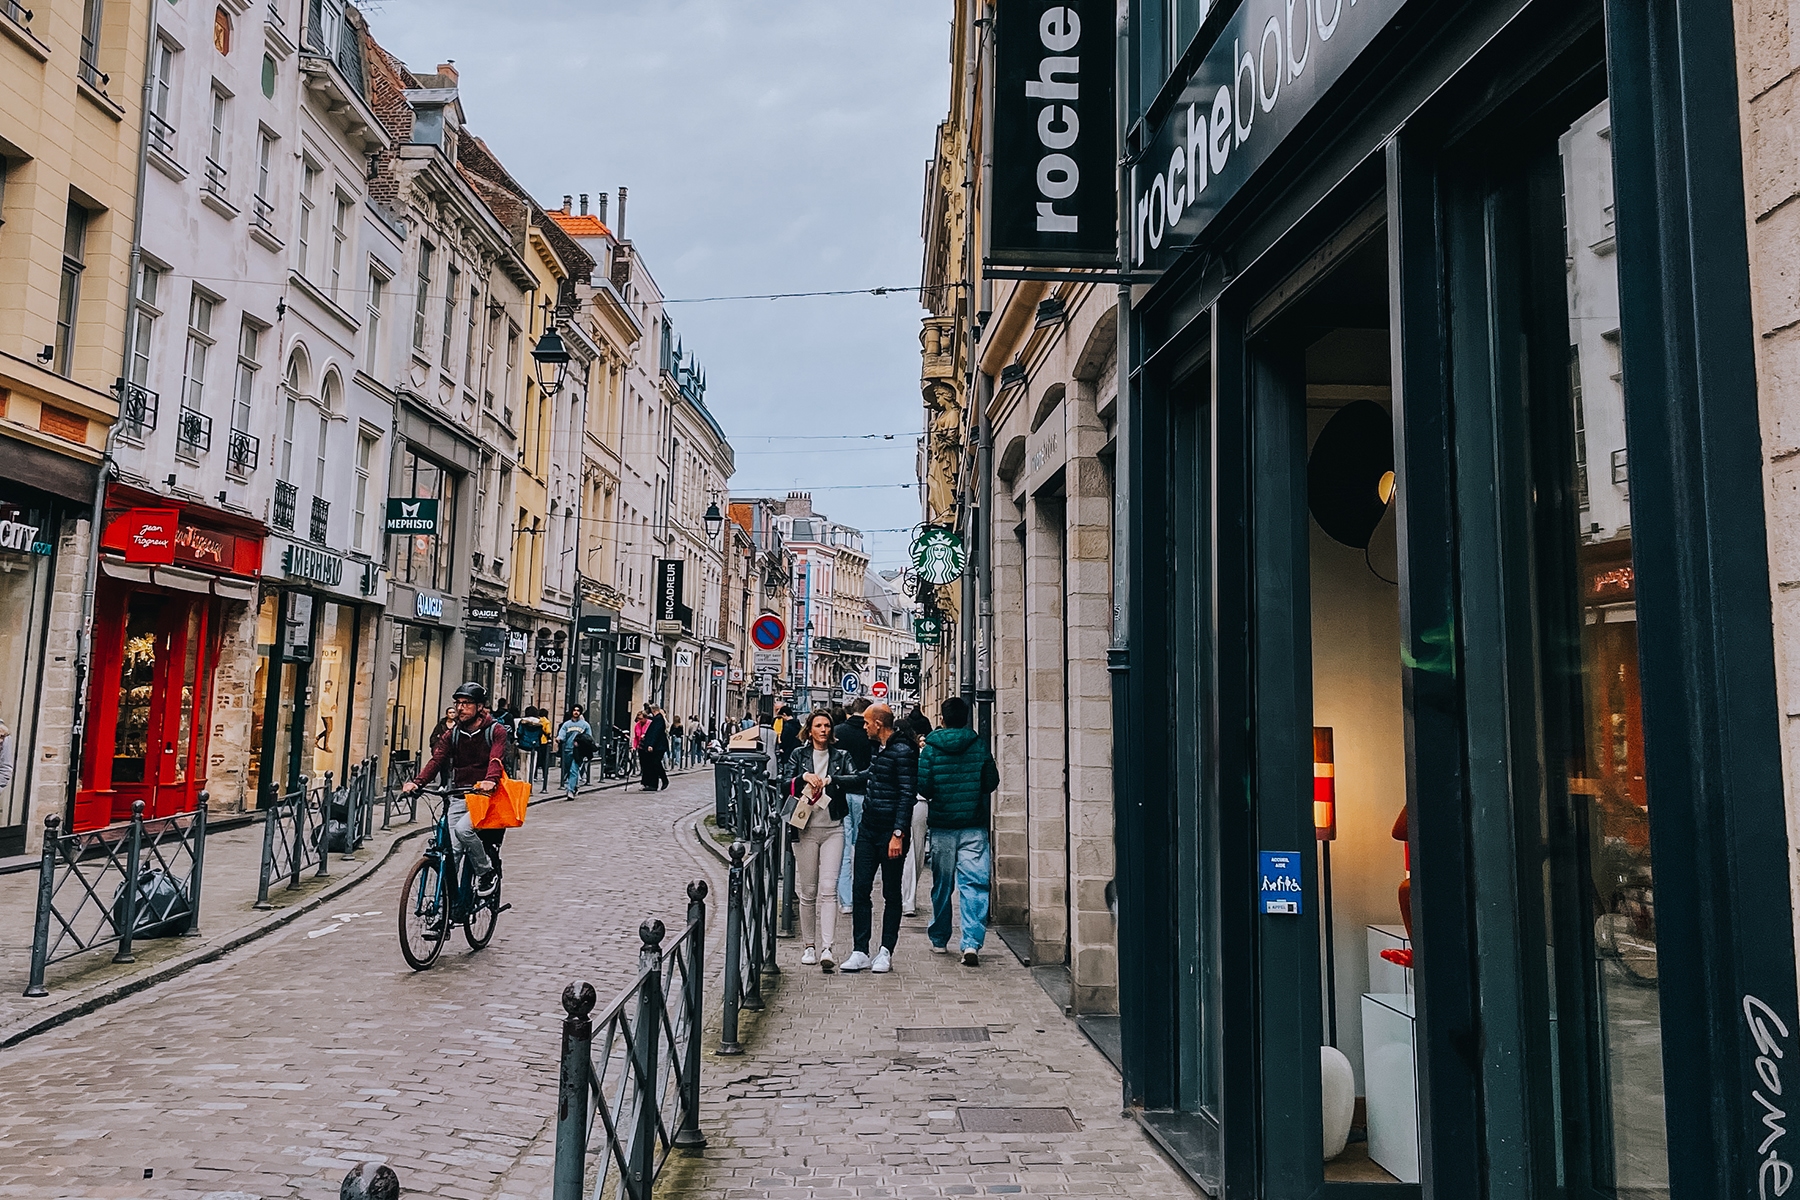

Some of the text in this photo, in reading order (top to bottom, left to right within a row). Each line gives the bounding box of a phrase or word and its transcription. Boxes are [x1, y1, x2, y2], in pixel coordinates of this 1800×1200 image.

[1025, 5, 1081, 234] roche
[1137, 0, 1358, 268] rochebob
[0, 520, 39, 552] CITY
[387, 519, 434, 530] MEPHISTO
[291, 545, 343, 587] MEPHISTO
[424, 596, 443, 617] AIGLE
[665, 563, 676, 620] ENCADREUR
